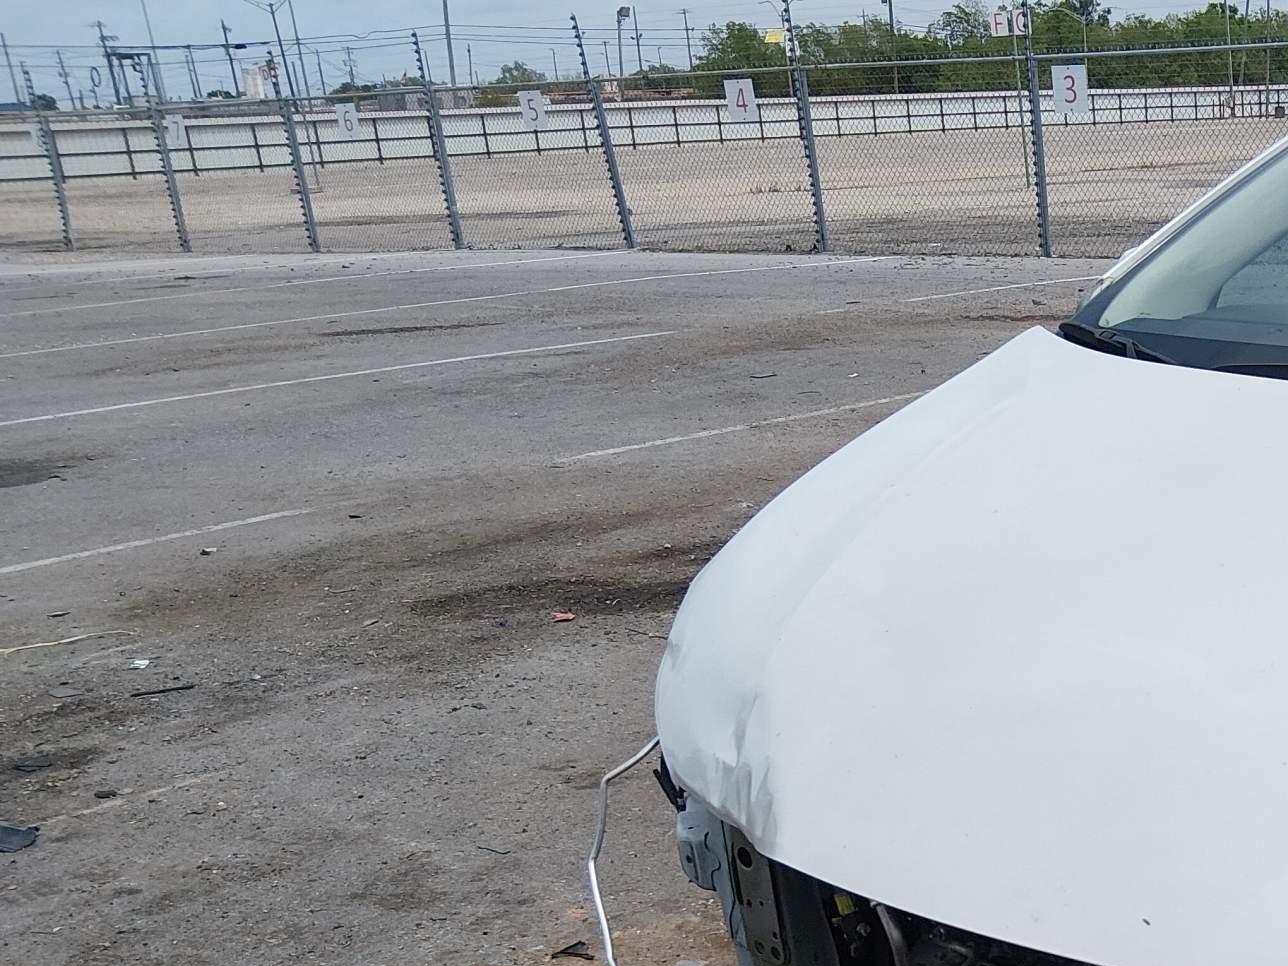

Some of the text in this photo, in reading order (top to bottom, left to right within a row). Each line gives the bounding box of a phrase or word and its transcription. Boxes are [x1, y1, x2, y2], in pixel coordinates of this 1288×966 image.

[735, 87, 749, 113] 4
[1063, 74, 1078, 104] 3
[342, 110, 354, 132] 6
[527, 98, 539, 122] 5
[171, 121, 181, 141] 7
